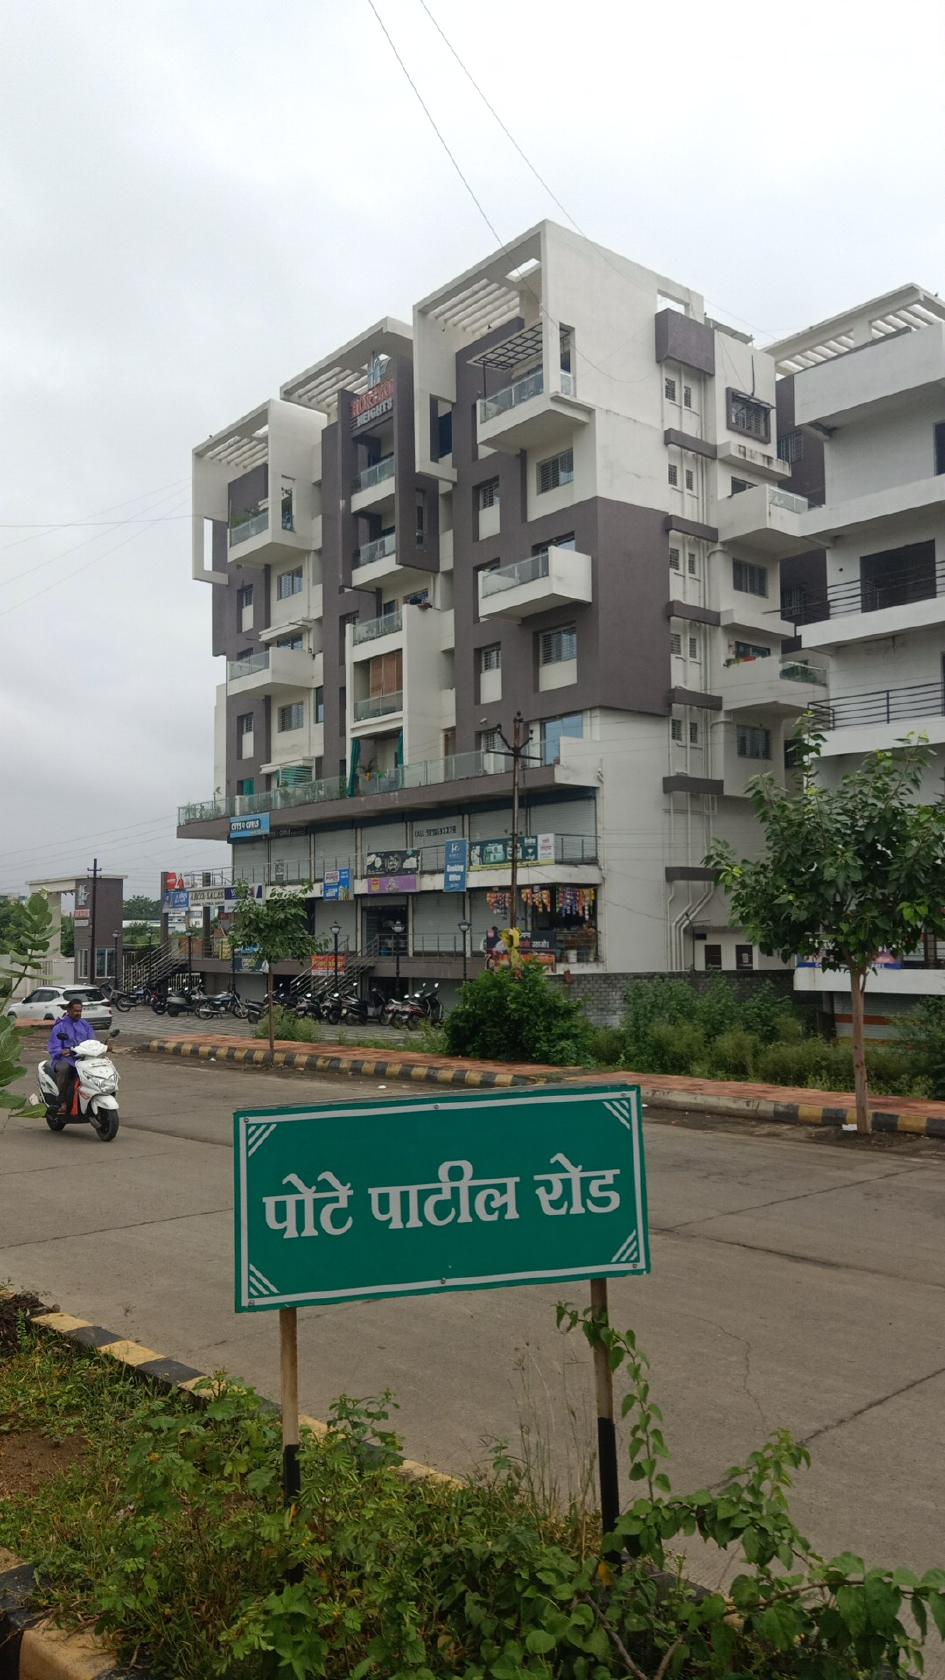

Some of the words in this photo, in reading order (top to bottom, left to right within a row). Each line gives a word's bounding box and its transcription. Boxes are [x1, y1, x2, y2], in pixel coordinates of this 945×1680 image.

[262, 1170, 354, 1239] पोटे
[367, 1159, 520, 1230] पाटील
[533, 1152, 621, 1216] रोड
